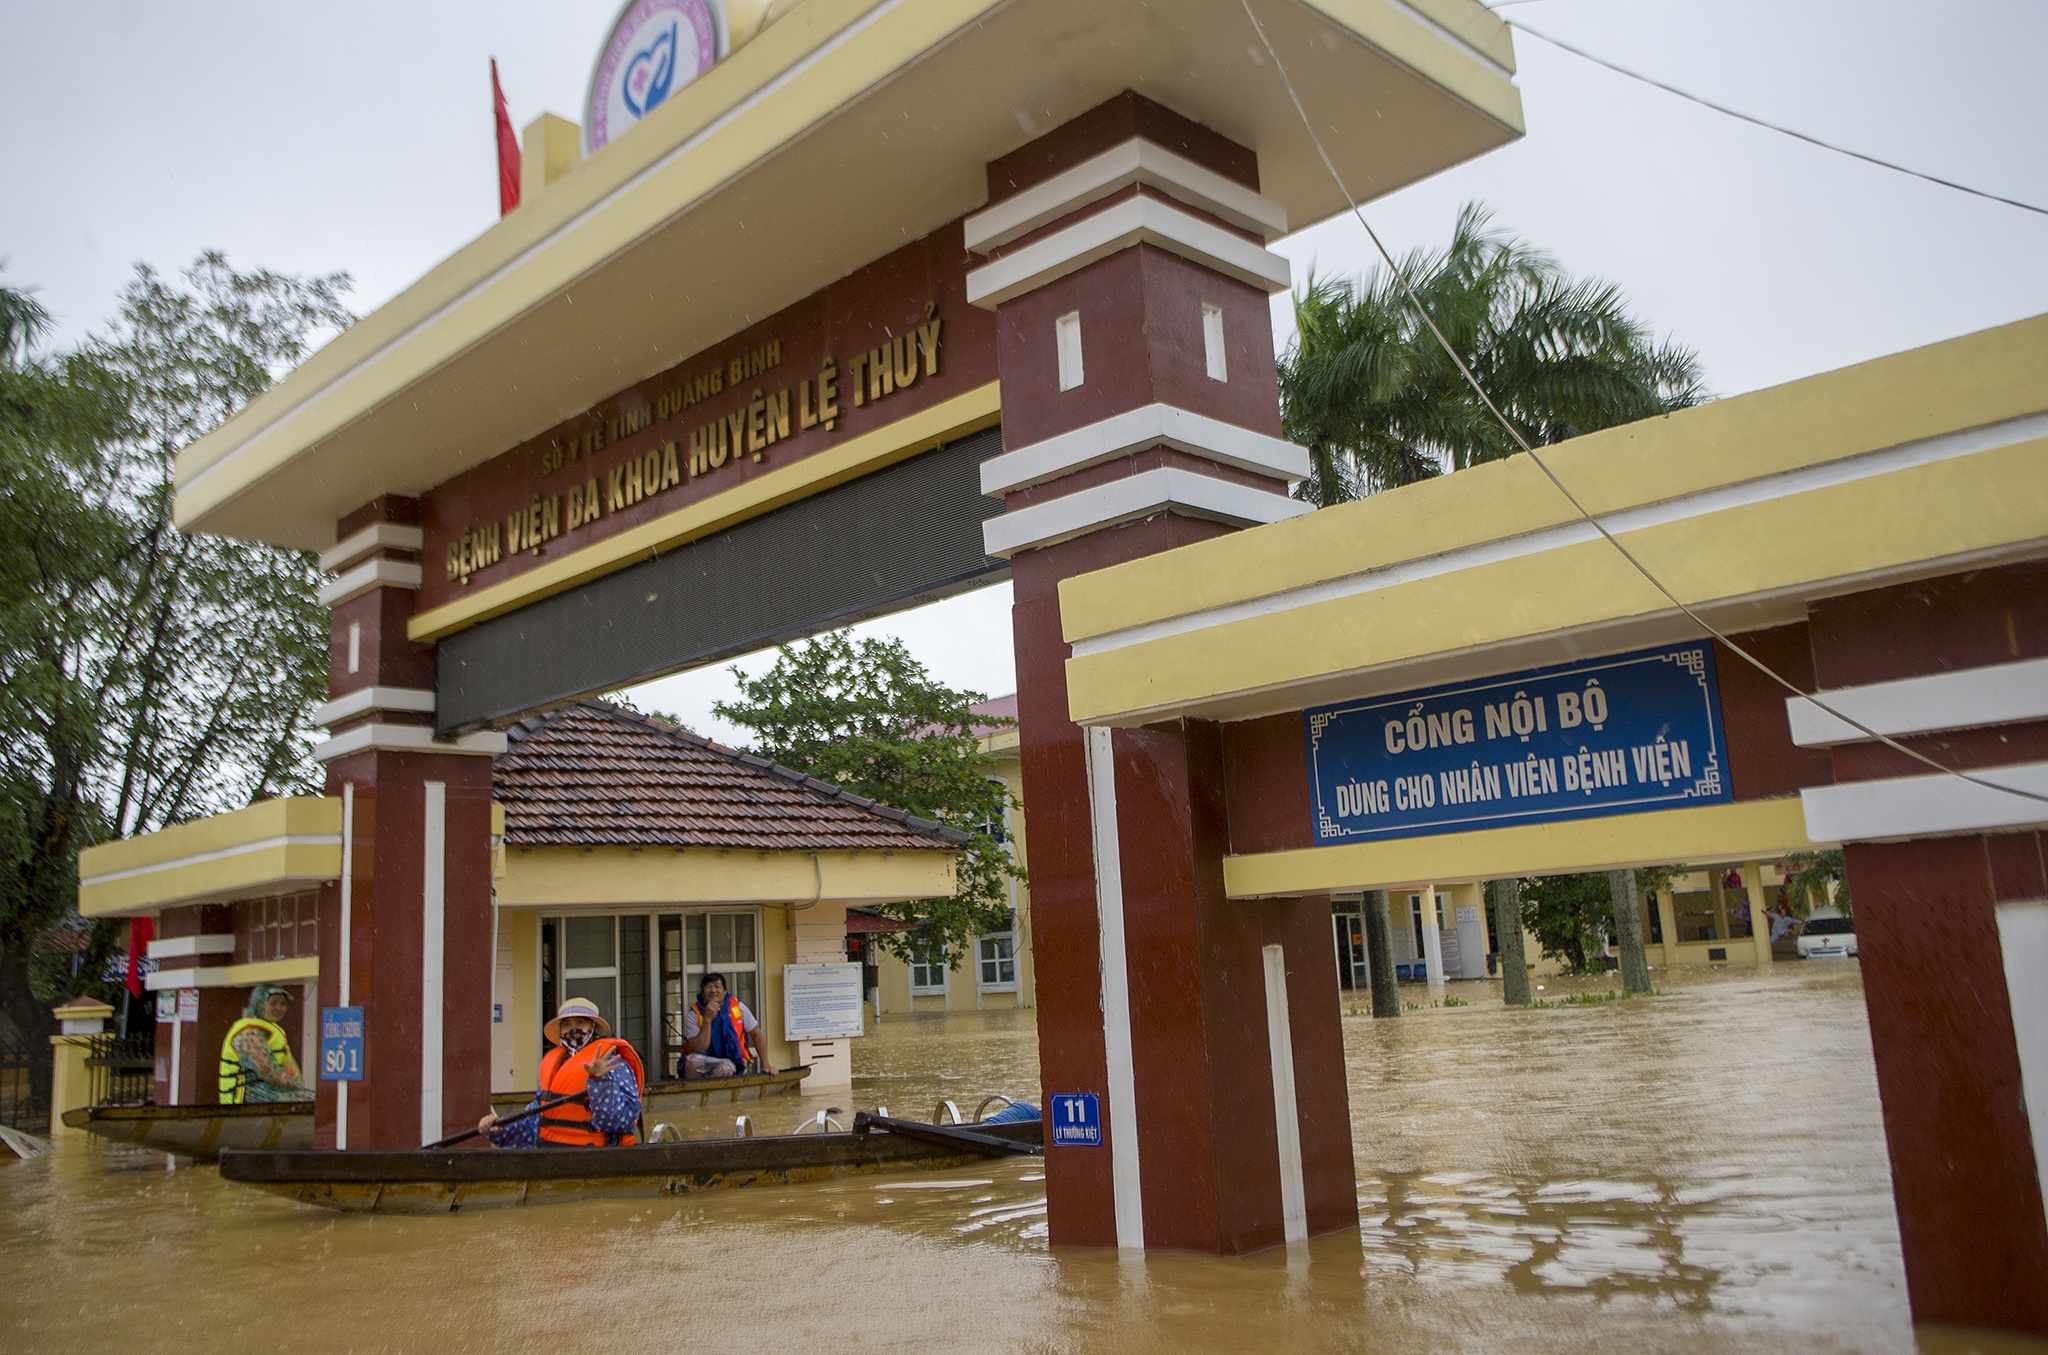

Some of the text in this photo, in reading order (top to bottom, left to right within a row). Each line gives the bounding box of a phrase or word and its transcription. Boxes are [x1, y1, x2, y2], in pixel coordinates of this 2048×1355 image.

[570, 439, 580, 461] Y
[730, 340, 782, 386] BÌNH
[446, 522, 500, 585] BỆNH
[508, 493, 560, 556] VIỆN
[608, 441, 679, 513] KHOA
[690, 388, 790, 478] HUYỆN
[801, 355, 838, 431] LỆ
[850, 301, 941, 407] THUỶ
[1384, 678, 1608, 755] CỔNG NỘI BỘ
[1336, 735, 1691, 818] DÙNG CHO NHÂN VIÊN BỆNH VIỆN
[326, 1040, 358, 1073] SỐ 1
[1064, 1099, 1085, 1123] 11
